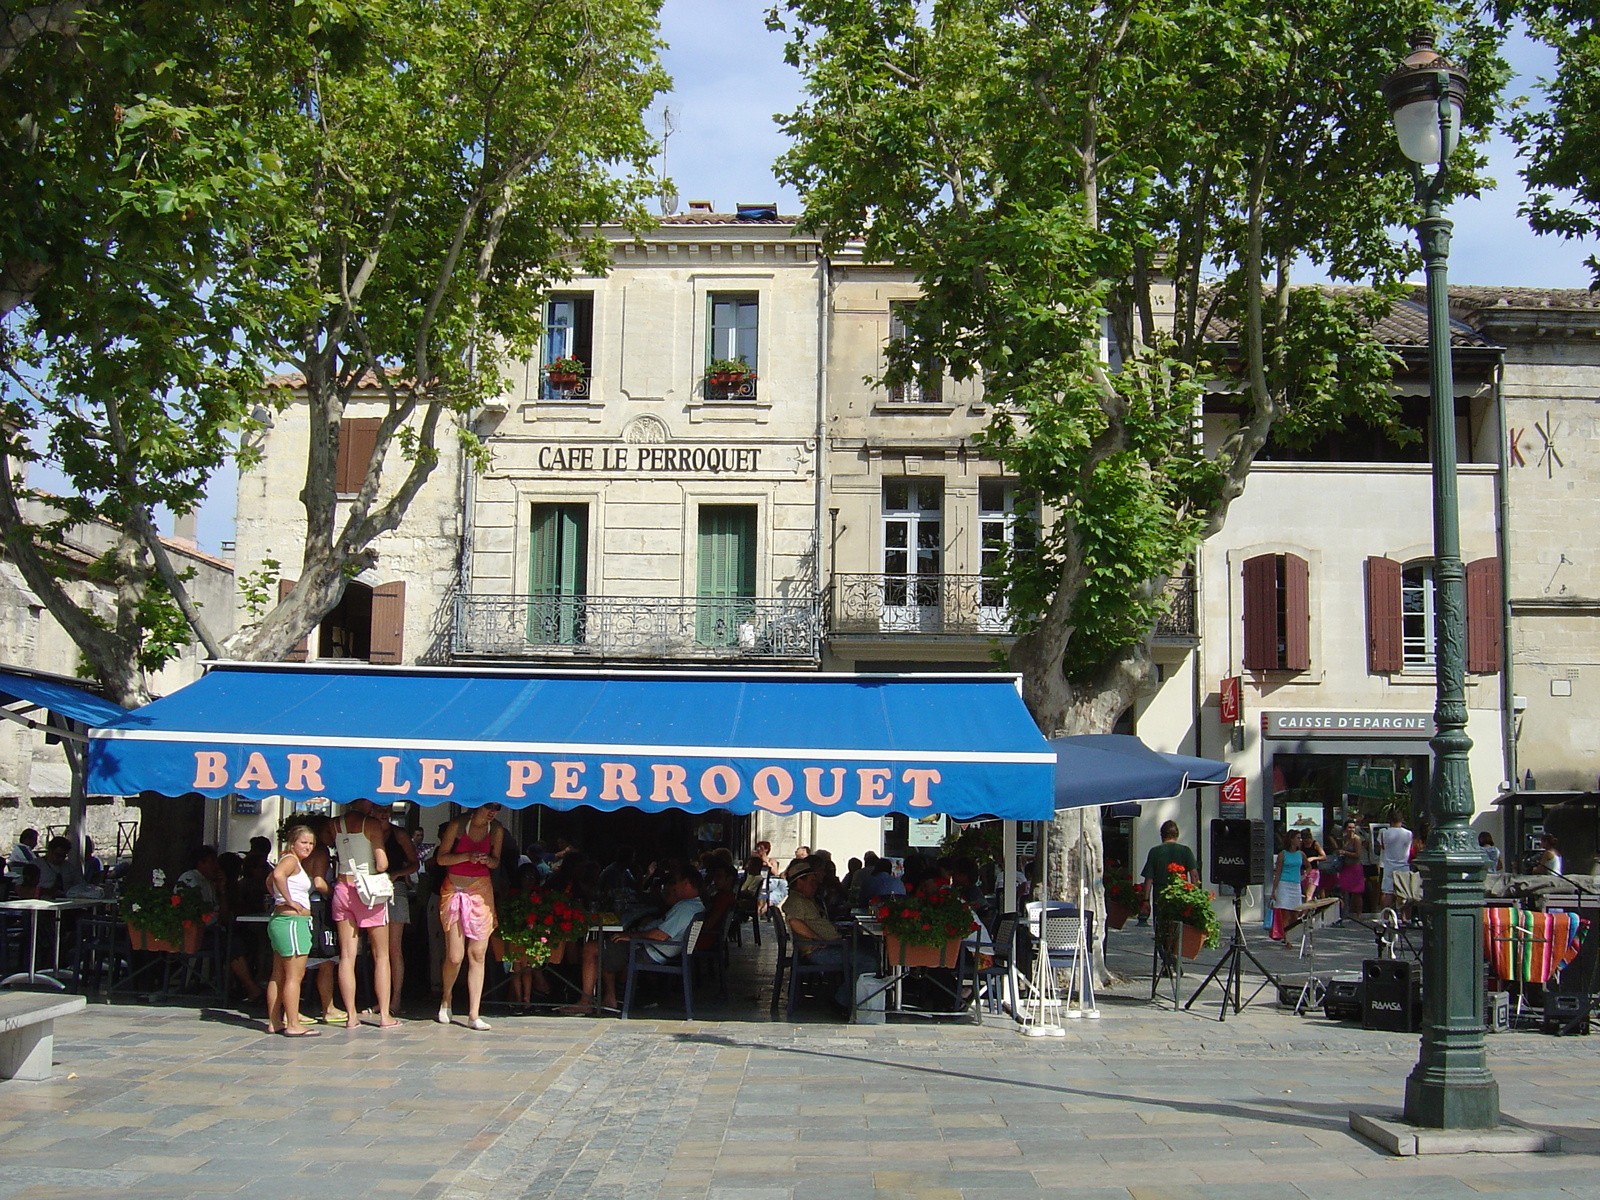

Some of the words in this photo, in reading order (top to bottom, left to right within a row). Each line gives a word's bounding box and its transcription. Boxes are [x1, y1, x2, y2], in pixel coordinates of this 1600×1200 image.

[538, 446, 593, 471] CAFE
[602, 447, 628, 471] LE
[637, 447, 762, 475] PERROQUET
[1278, 716, 1332, 728] CAISSE
[1338, 716, 1427, 729] D'EPARGNE
[192, 750, 326, 792] BAR
[376, 755, 455, 797] LE
[506, 759, 942, 814] PERROQUET
[1218, 856, 1245, 865] RAMSA
[1371, 1000, 1403, 1011] RAMSA
